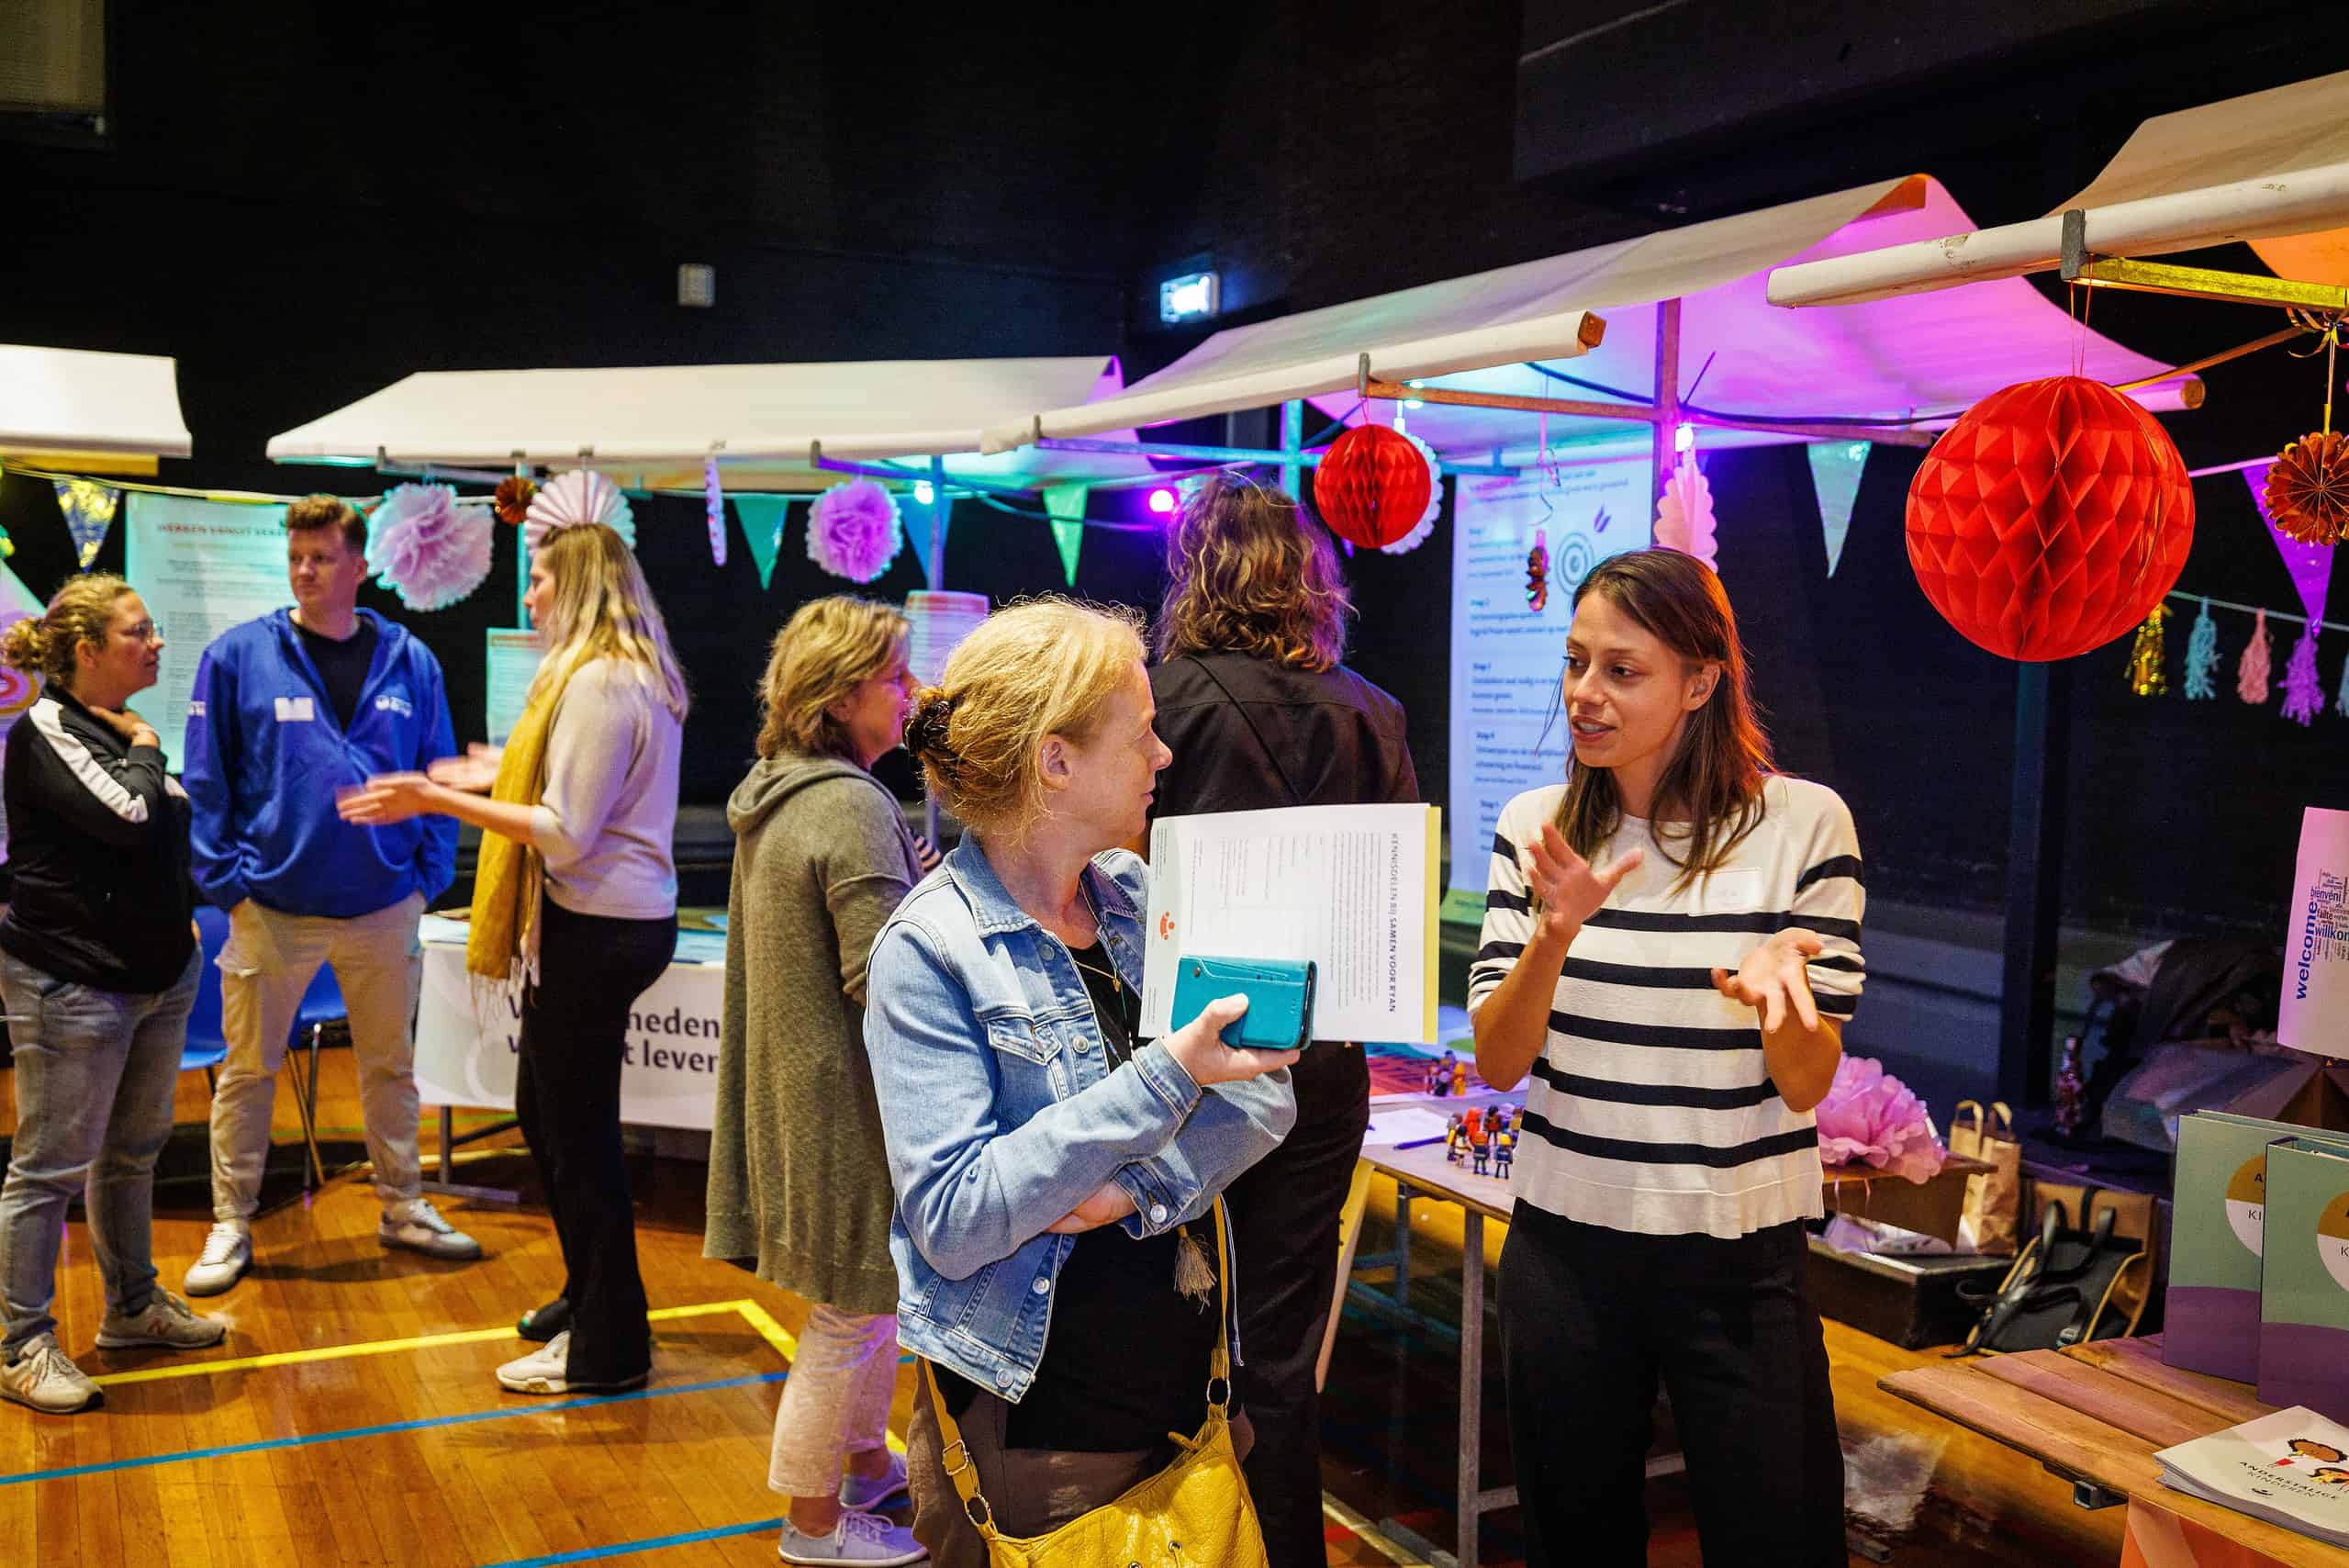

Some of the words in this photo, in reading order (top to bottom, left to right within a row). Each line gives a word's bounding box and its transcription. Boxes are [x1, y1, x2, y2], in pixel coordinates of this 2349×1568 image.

[1389, 917, 1398, 953] SAMEN
[2296, 901, 2318, 1000] welcome
[1389, 955, 1397, 982] VOOR
